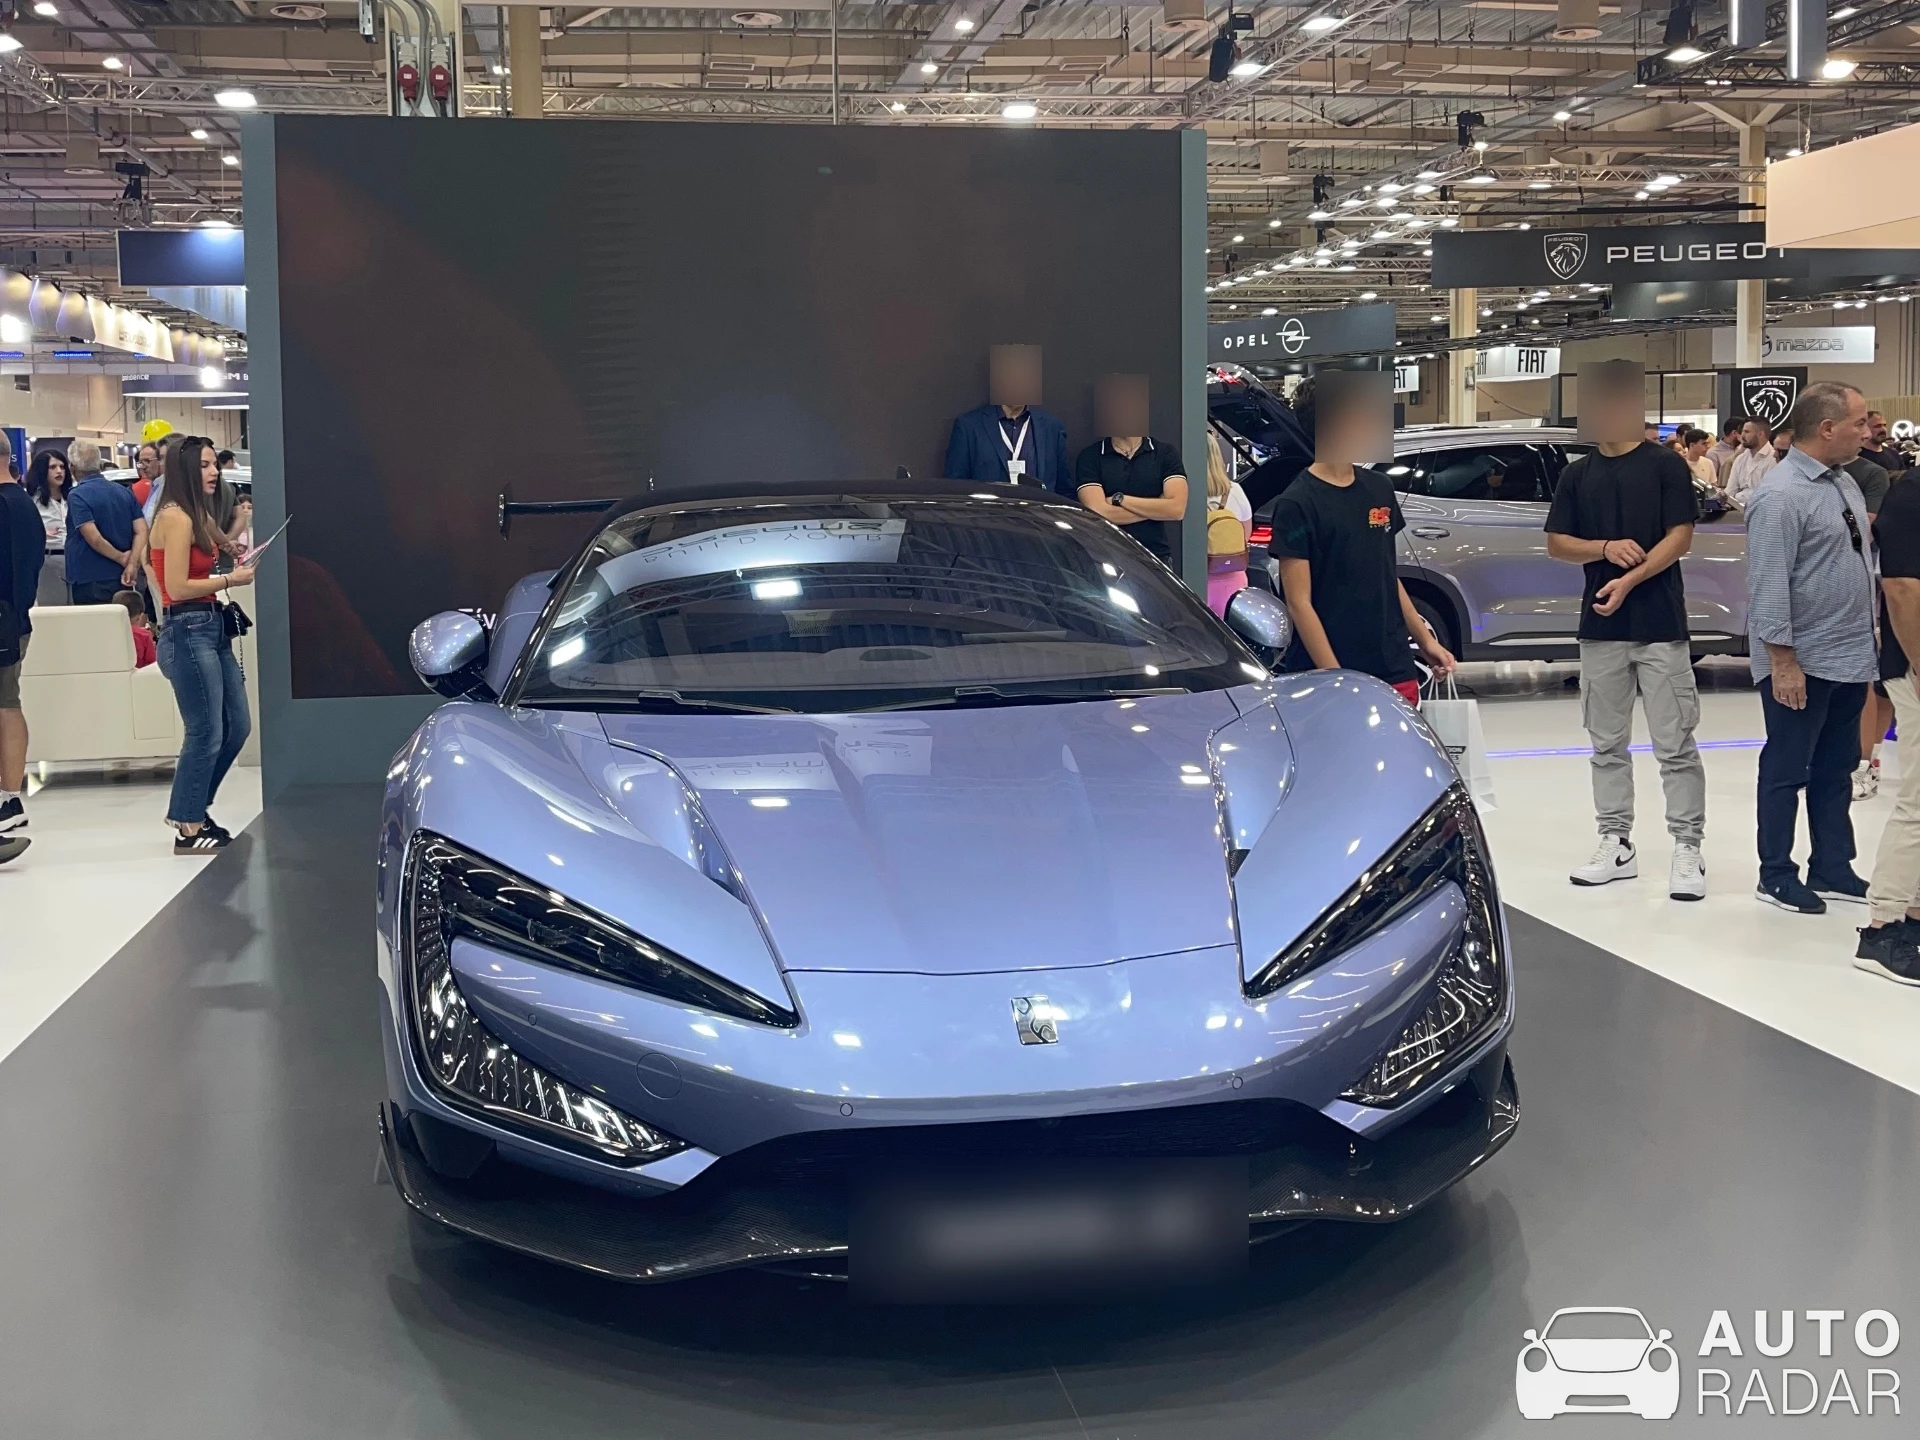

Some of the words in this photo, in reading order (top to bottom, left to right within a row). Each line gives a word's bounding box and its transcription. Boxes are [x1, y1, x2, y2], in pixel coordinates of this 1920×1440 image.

[1223, 333, 1269, 349] OPEL
[1517, 349, 1547, 373] FIAT
[1745, 379, 1793, 387] PEUGEOT
